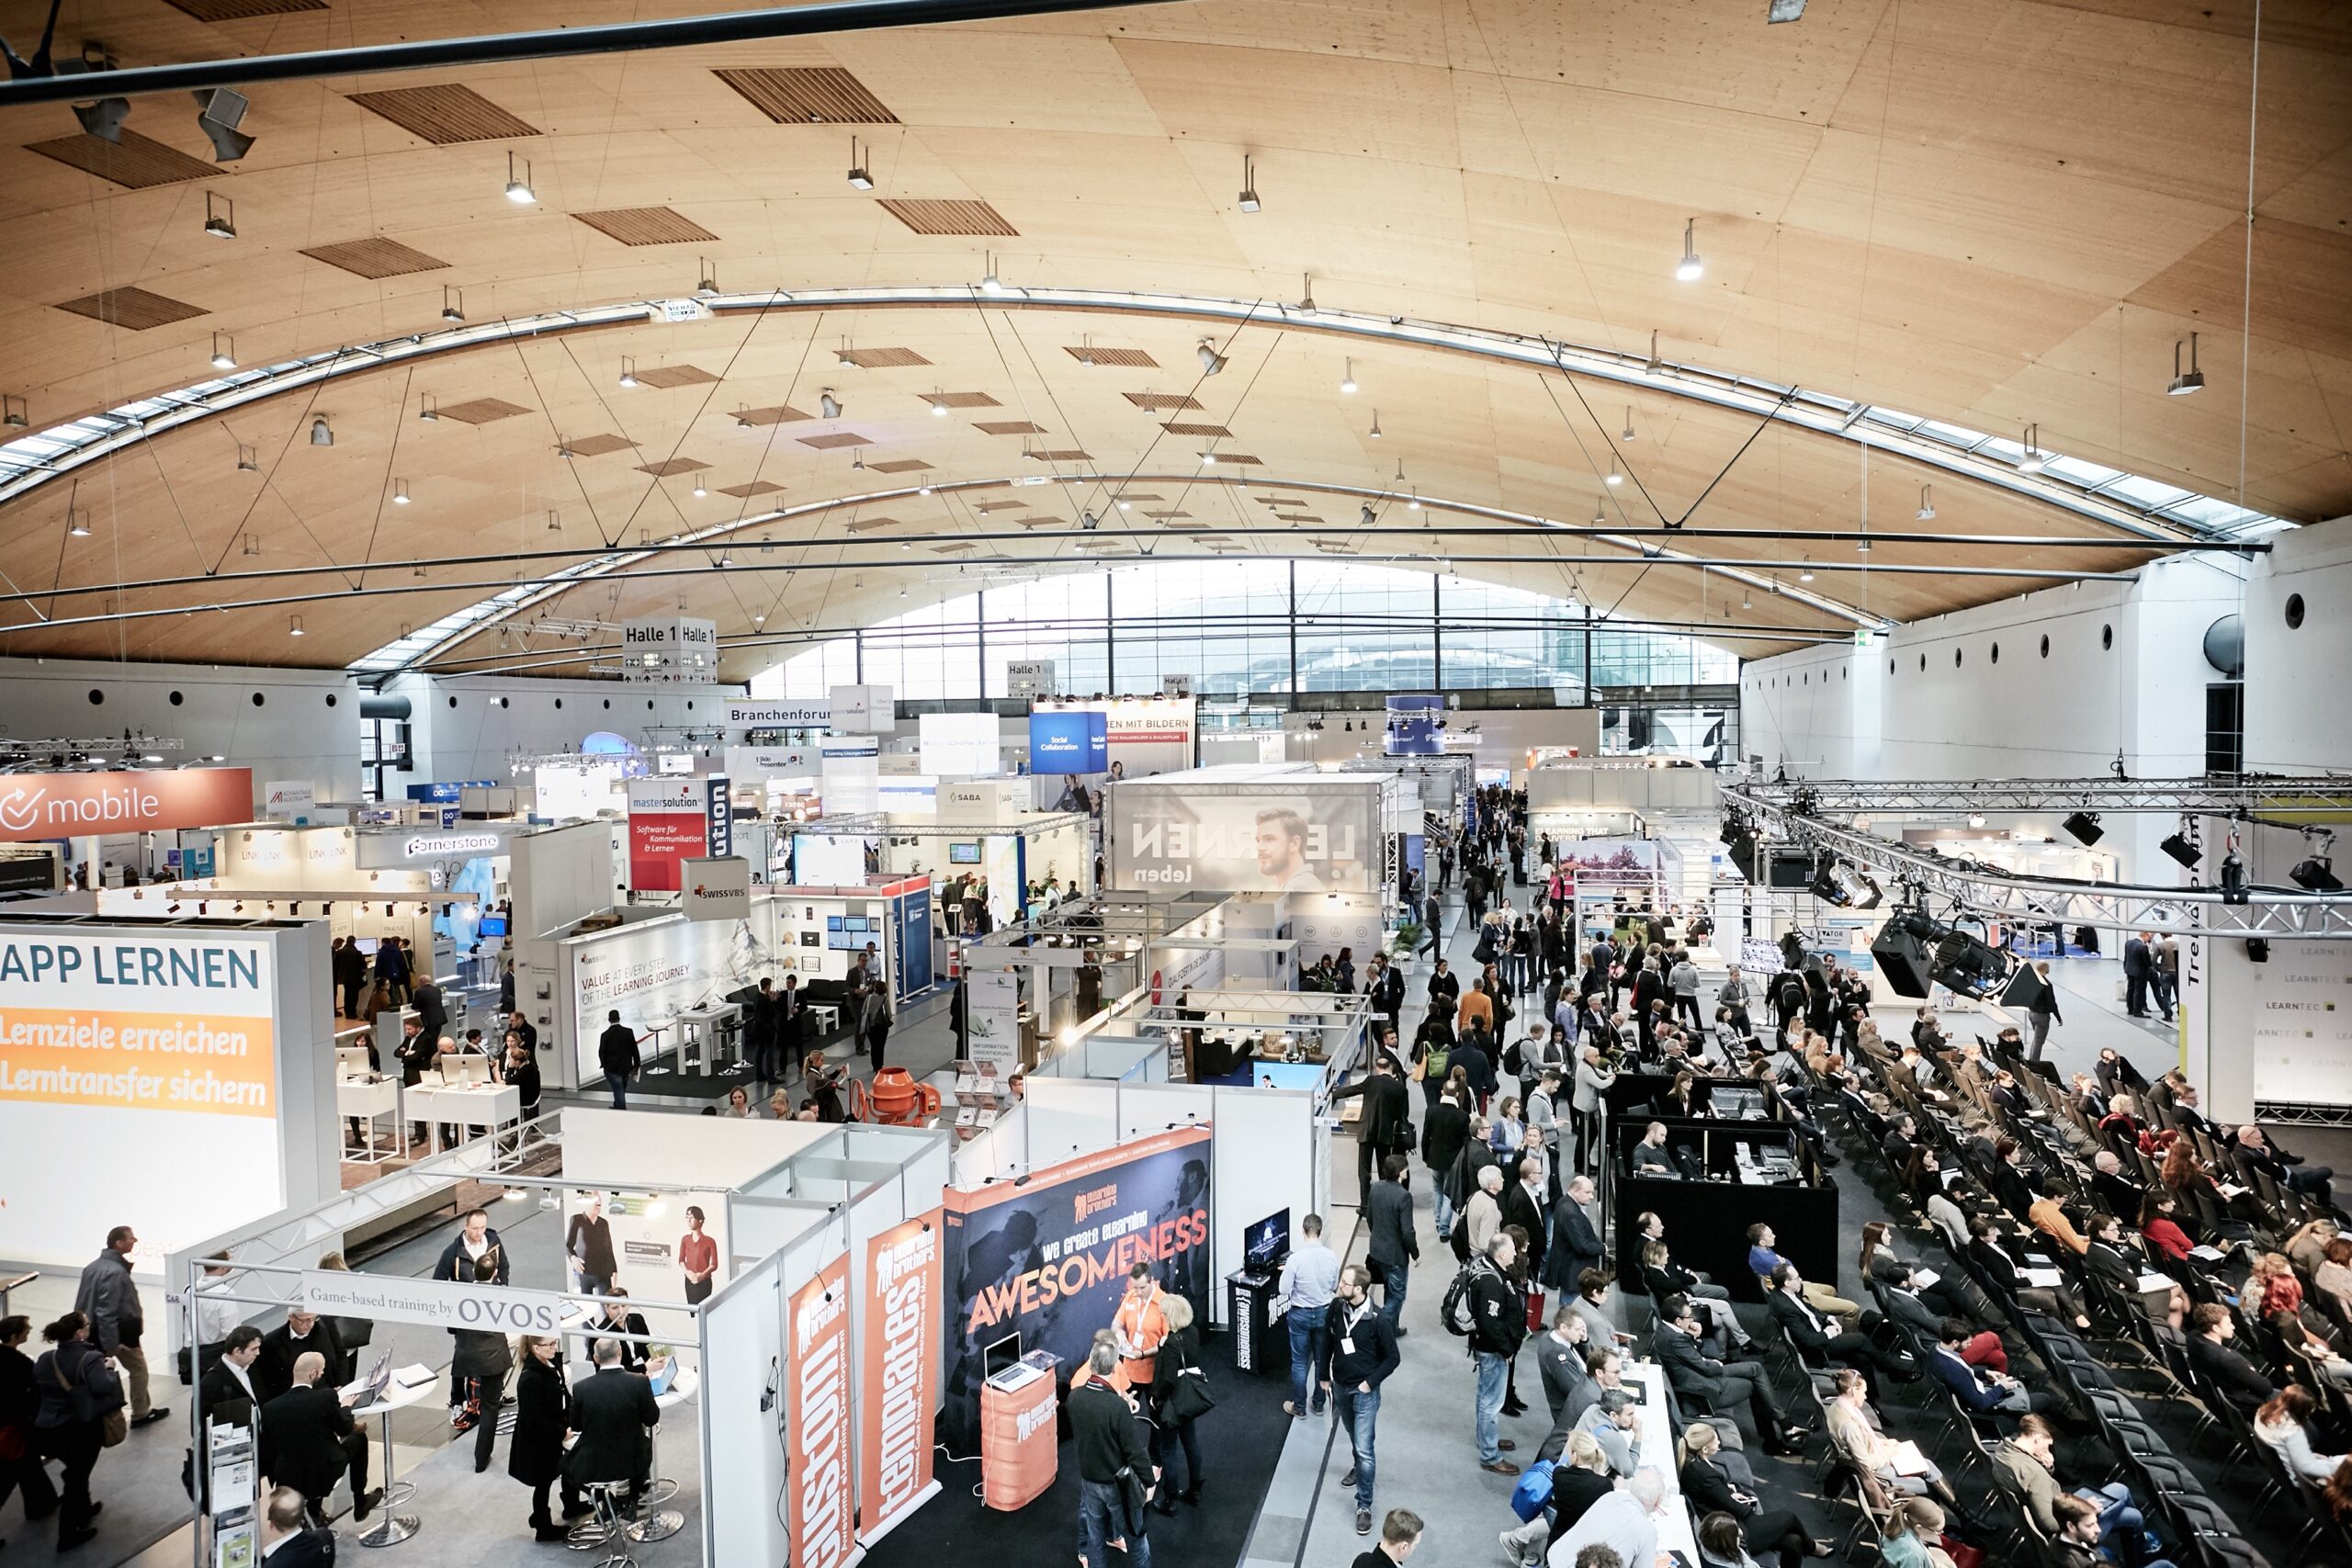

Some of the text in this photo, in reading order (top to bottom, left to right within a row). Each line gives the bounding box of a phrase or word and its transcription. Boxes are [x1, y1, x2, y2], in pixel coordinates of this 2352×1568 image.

[627, 626, 676, 642] Halle 1
[683, 626, 714, 643] Halle 1
[1009, 665, 1040, 674] Halle 1
[731, 709, 831, 721] Branchenforu
[1125, 720, 1141, 728] MIT
[1147, 719, 1189, 728] BILDERN
[283, 789, 311, 797] ADVANTAGE
[48, 787, 159, 824] mobile
[633, 796, 697, 807] mastersolution
[637, 826, 677, 834] Software für
[650, 834, 703, 843] Kommunikation
[702, 889, 745, 898] SWISSVBS
[0, 944, 259, 989] APP LERNEN
[582, 957, 666, 990] VALUE AT EVERY STEP
[582, 993, 594, 1006] OF
[596, 987, 611, 999] THE
[614, 975, 653, 996] LEARNING
[655, 964, 689, 984] JOURNEY
[2285, 975, 2339, 984] LEARNTEC
[2267, 1002, 2320, 1011] LEARNTEC
[0, 1015, 247, 1056] Lernziele erreichen
[0, 1060, 266, 1106] Lerntransfer sichern
[1064, 1228, 1098, 1256] create
[967, 1209, 1207, 1335] AWESOMENESS
[311, 1288, 385, 1307] Game-based
[389, 1298, 436, 1315] training
[439, 1301, 454, 1318] by
